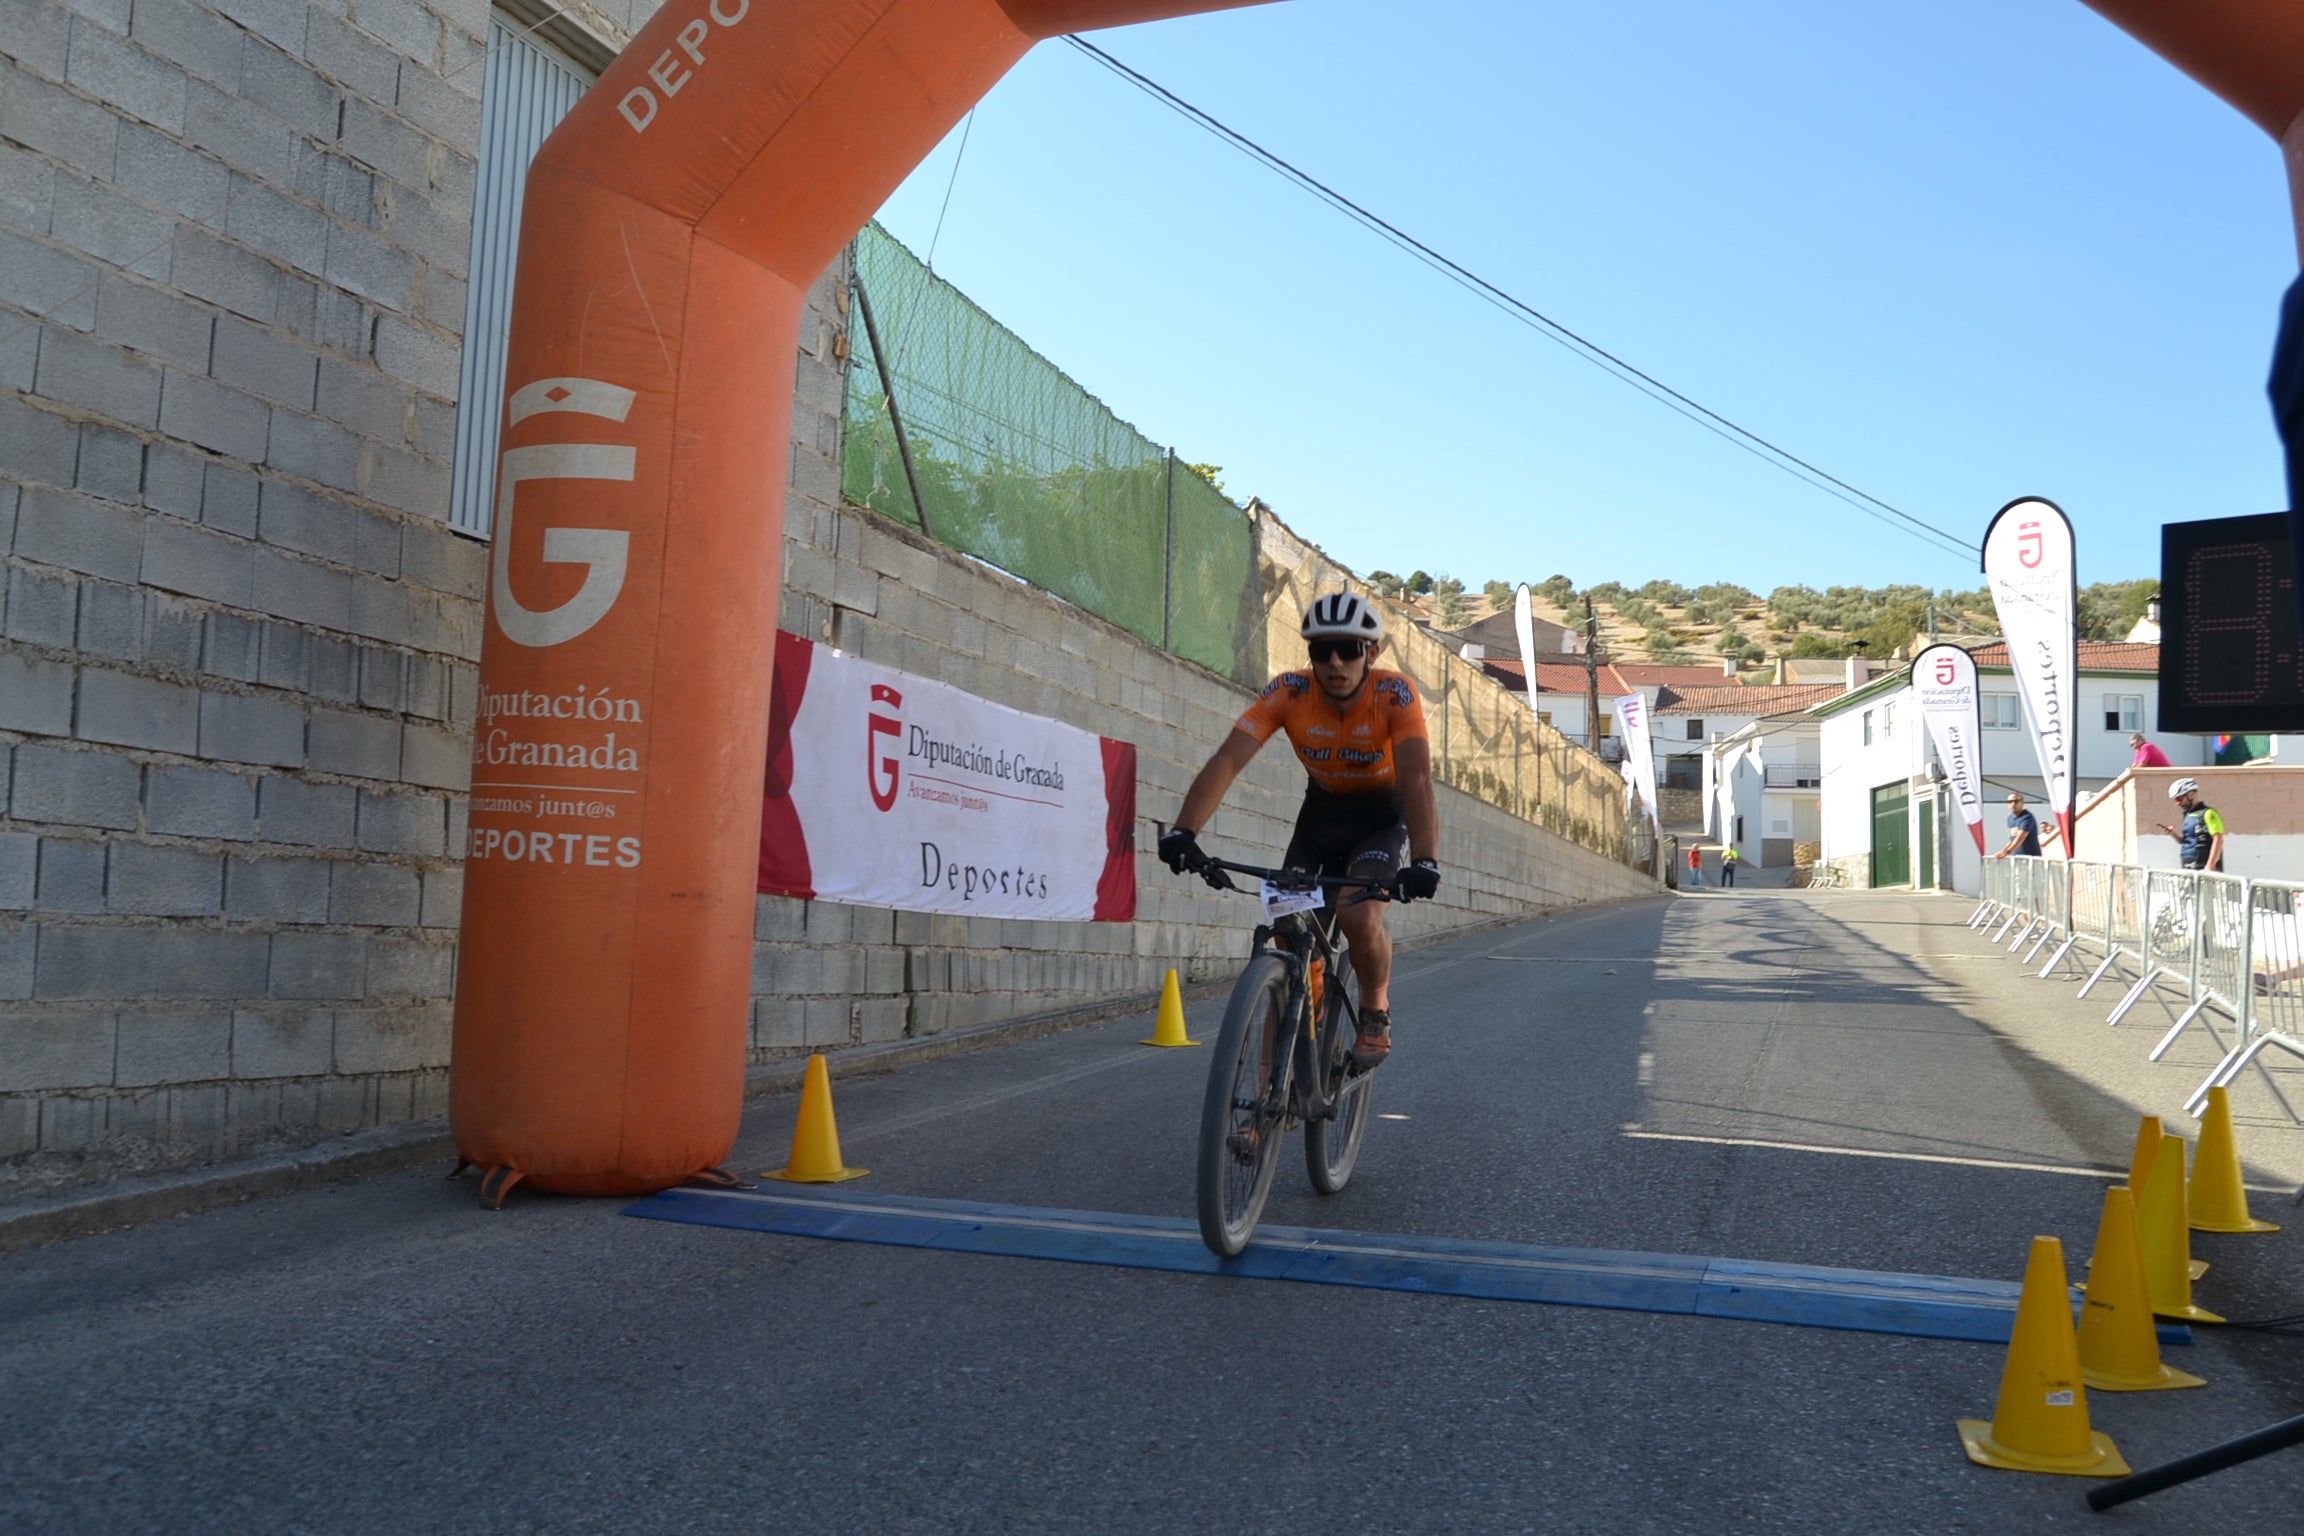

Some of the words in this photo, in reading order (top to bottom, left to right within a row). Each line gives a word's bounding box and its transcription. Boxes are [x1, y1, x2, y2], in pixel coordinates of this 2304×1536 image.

[486, 728, 640, 772] Granada
[907, 724, 993, 776] Diputación
[995, 748, 1012, 781] de
[1013, 753, 1065, 792] Granada
[1301, 745, 1331, 761] Bull
[1337, 746, 1385, 764] Bikes
[536, 793, 616, 818] junt@s
[920, 842, 1048, 901] Deportes
